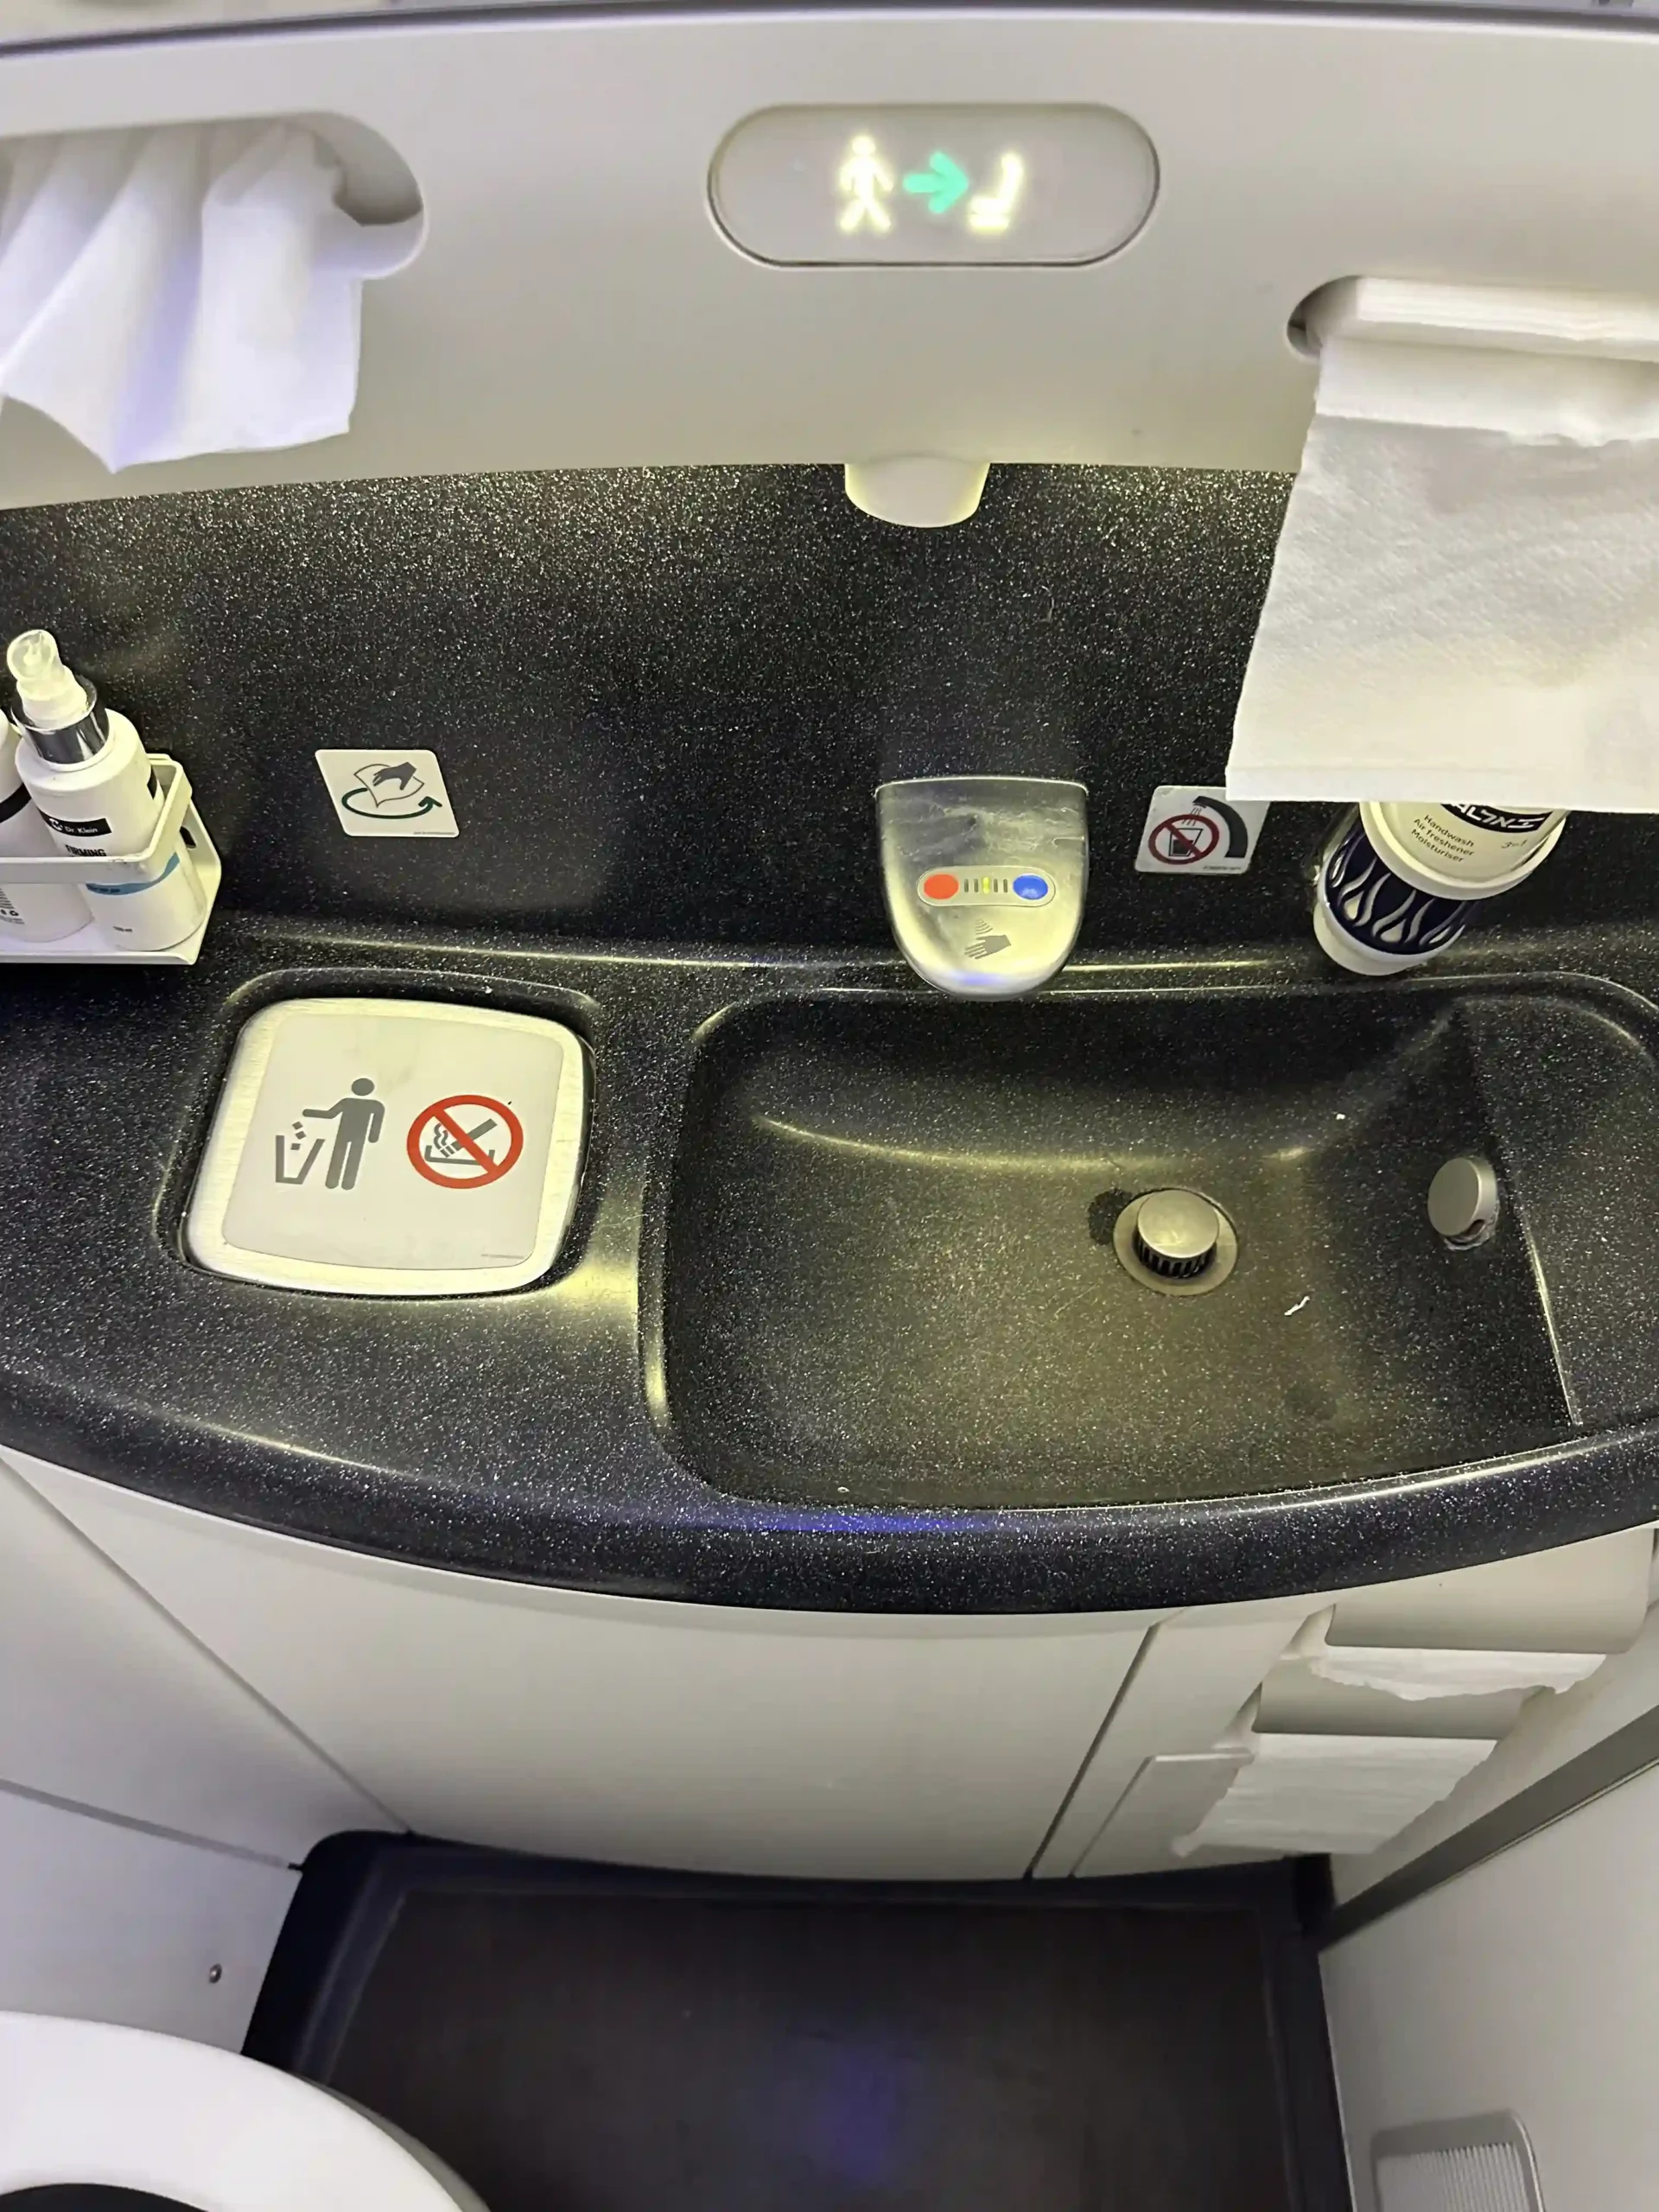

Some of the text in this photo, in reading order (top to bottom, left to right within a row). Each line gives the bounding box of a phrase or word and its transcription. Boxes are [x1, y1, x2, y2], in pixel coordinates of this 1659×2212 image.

[1411, 829, 1464, 862] Moisturiser
[1414, 818, 1474, 855] Air freshener
[1424, 815, 1474, 848] Handwash
[65, 844, 107, 857] FIRMING
